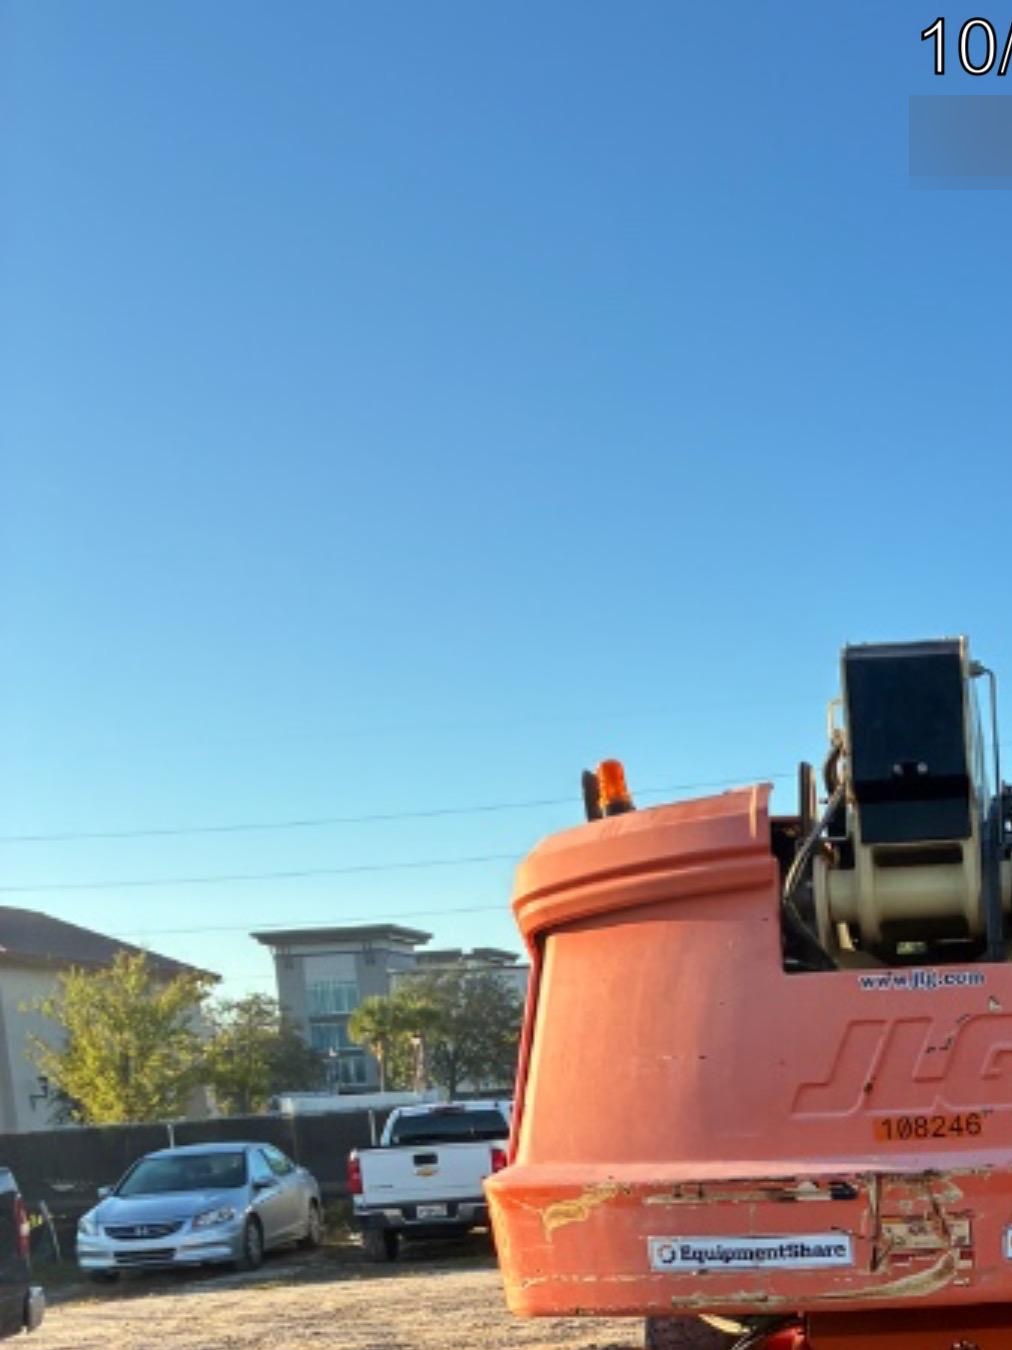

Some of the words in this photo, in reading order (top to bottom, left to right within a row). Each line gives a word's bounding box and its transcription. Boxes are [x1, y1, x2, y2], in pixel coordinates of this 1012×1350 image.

[859, 969, 986, 989] www.jlg.com
[881, 1112, 982, 1140] 108246
[679, 1242, 847, 1264] EquipmentShare
